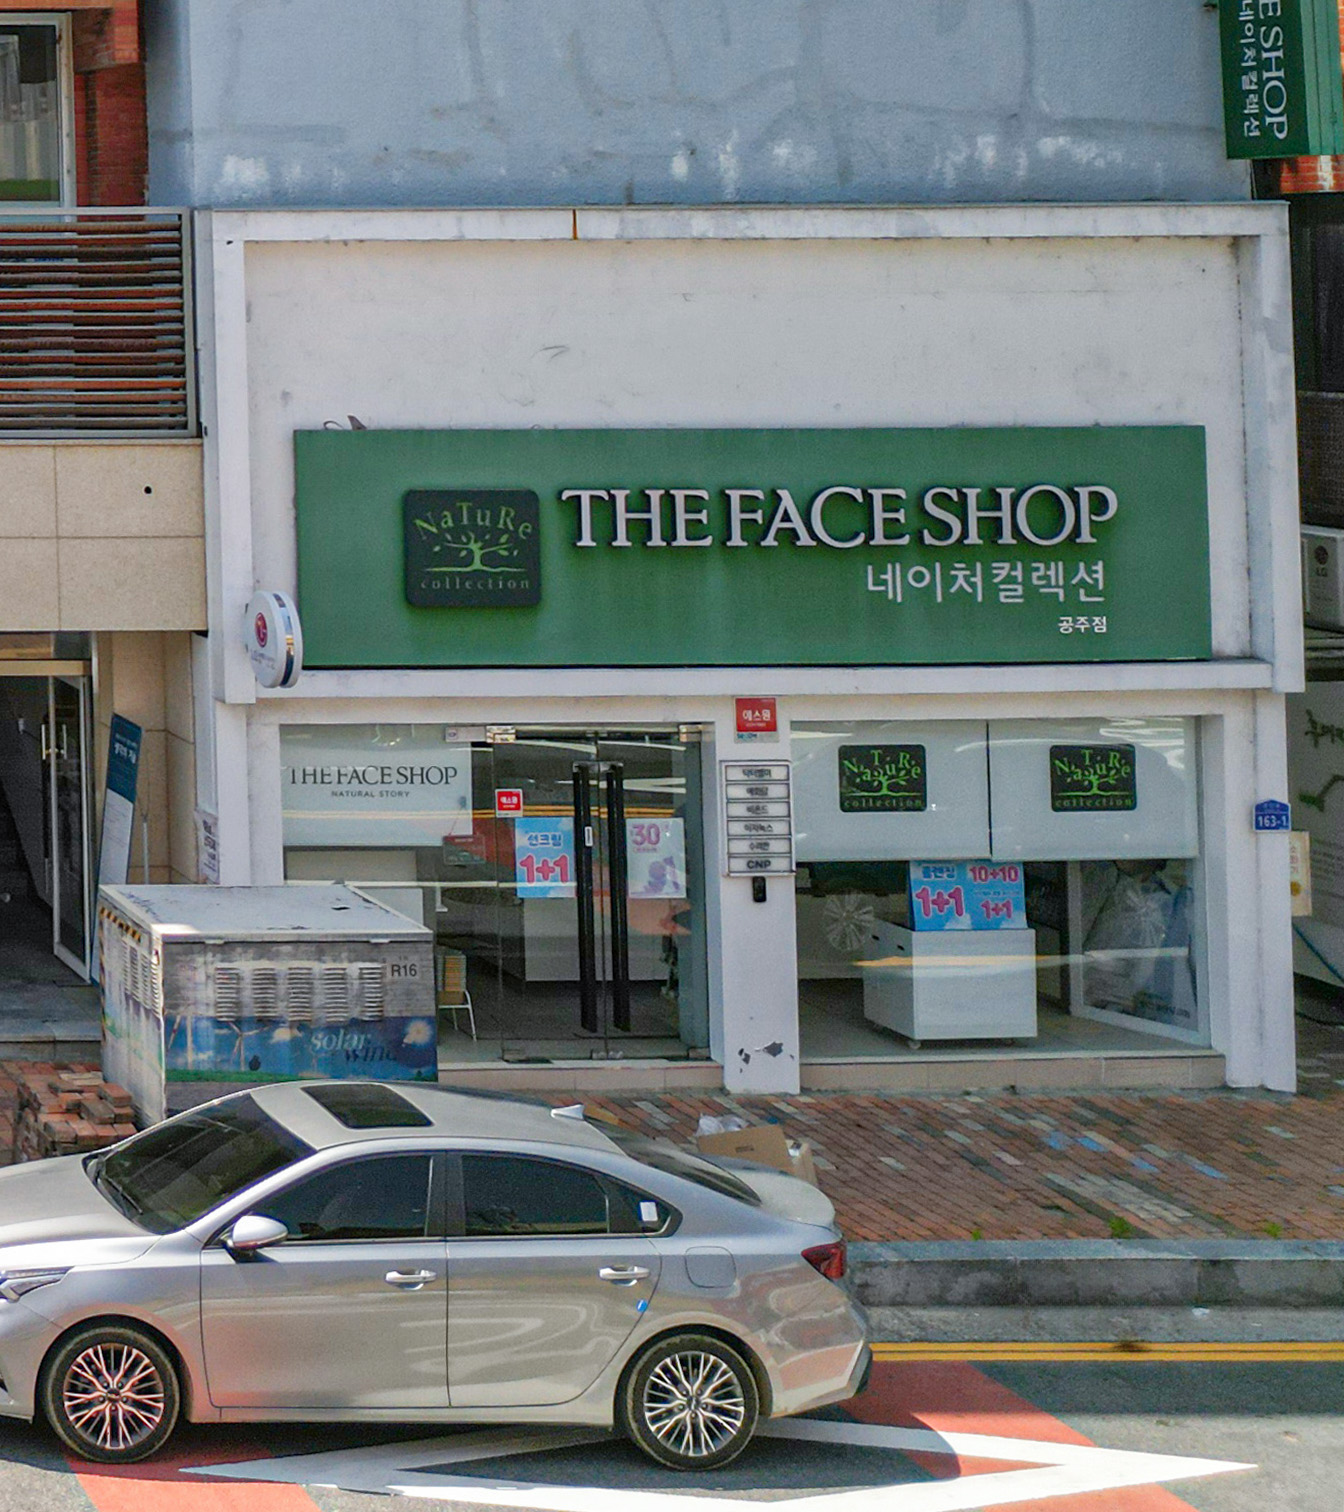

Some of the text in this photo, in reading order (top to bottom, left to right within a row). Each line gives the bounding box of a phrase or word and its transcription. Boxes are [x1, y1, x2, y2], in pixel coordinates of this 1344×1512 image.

[1259, 24, 1290, 141] SHOP
[561, 484, 1119, 549] THE FACE SHOP
[420, 576, 529, 590] collection
[867, 559, 1106, 603] 네이처컬렉션
[1057, 615, 1108, 635] 공주점
[742, 709, 772, 721] 에스원
[289, 765, 458, 786] THE FACE SHOP
[331, 790, 411, 798] NATURAL STORY
[1257, 815, 1287, 827] 163-1
[527, 832, 562, 847] 선크림
[631, 823, 661, 847] 30
[518, 853, 570, 884] 1+1
[746, 859, 772, 870] CNP
[969, 865, 1019, 883] 10+10
[915, 886, 964, 918] 1+1
[980, 899, 1012, 919] 1+1
[390, 963, 418, 978] R16
[311, 1028, 370, 1050] solar
